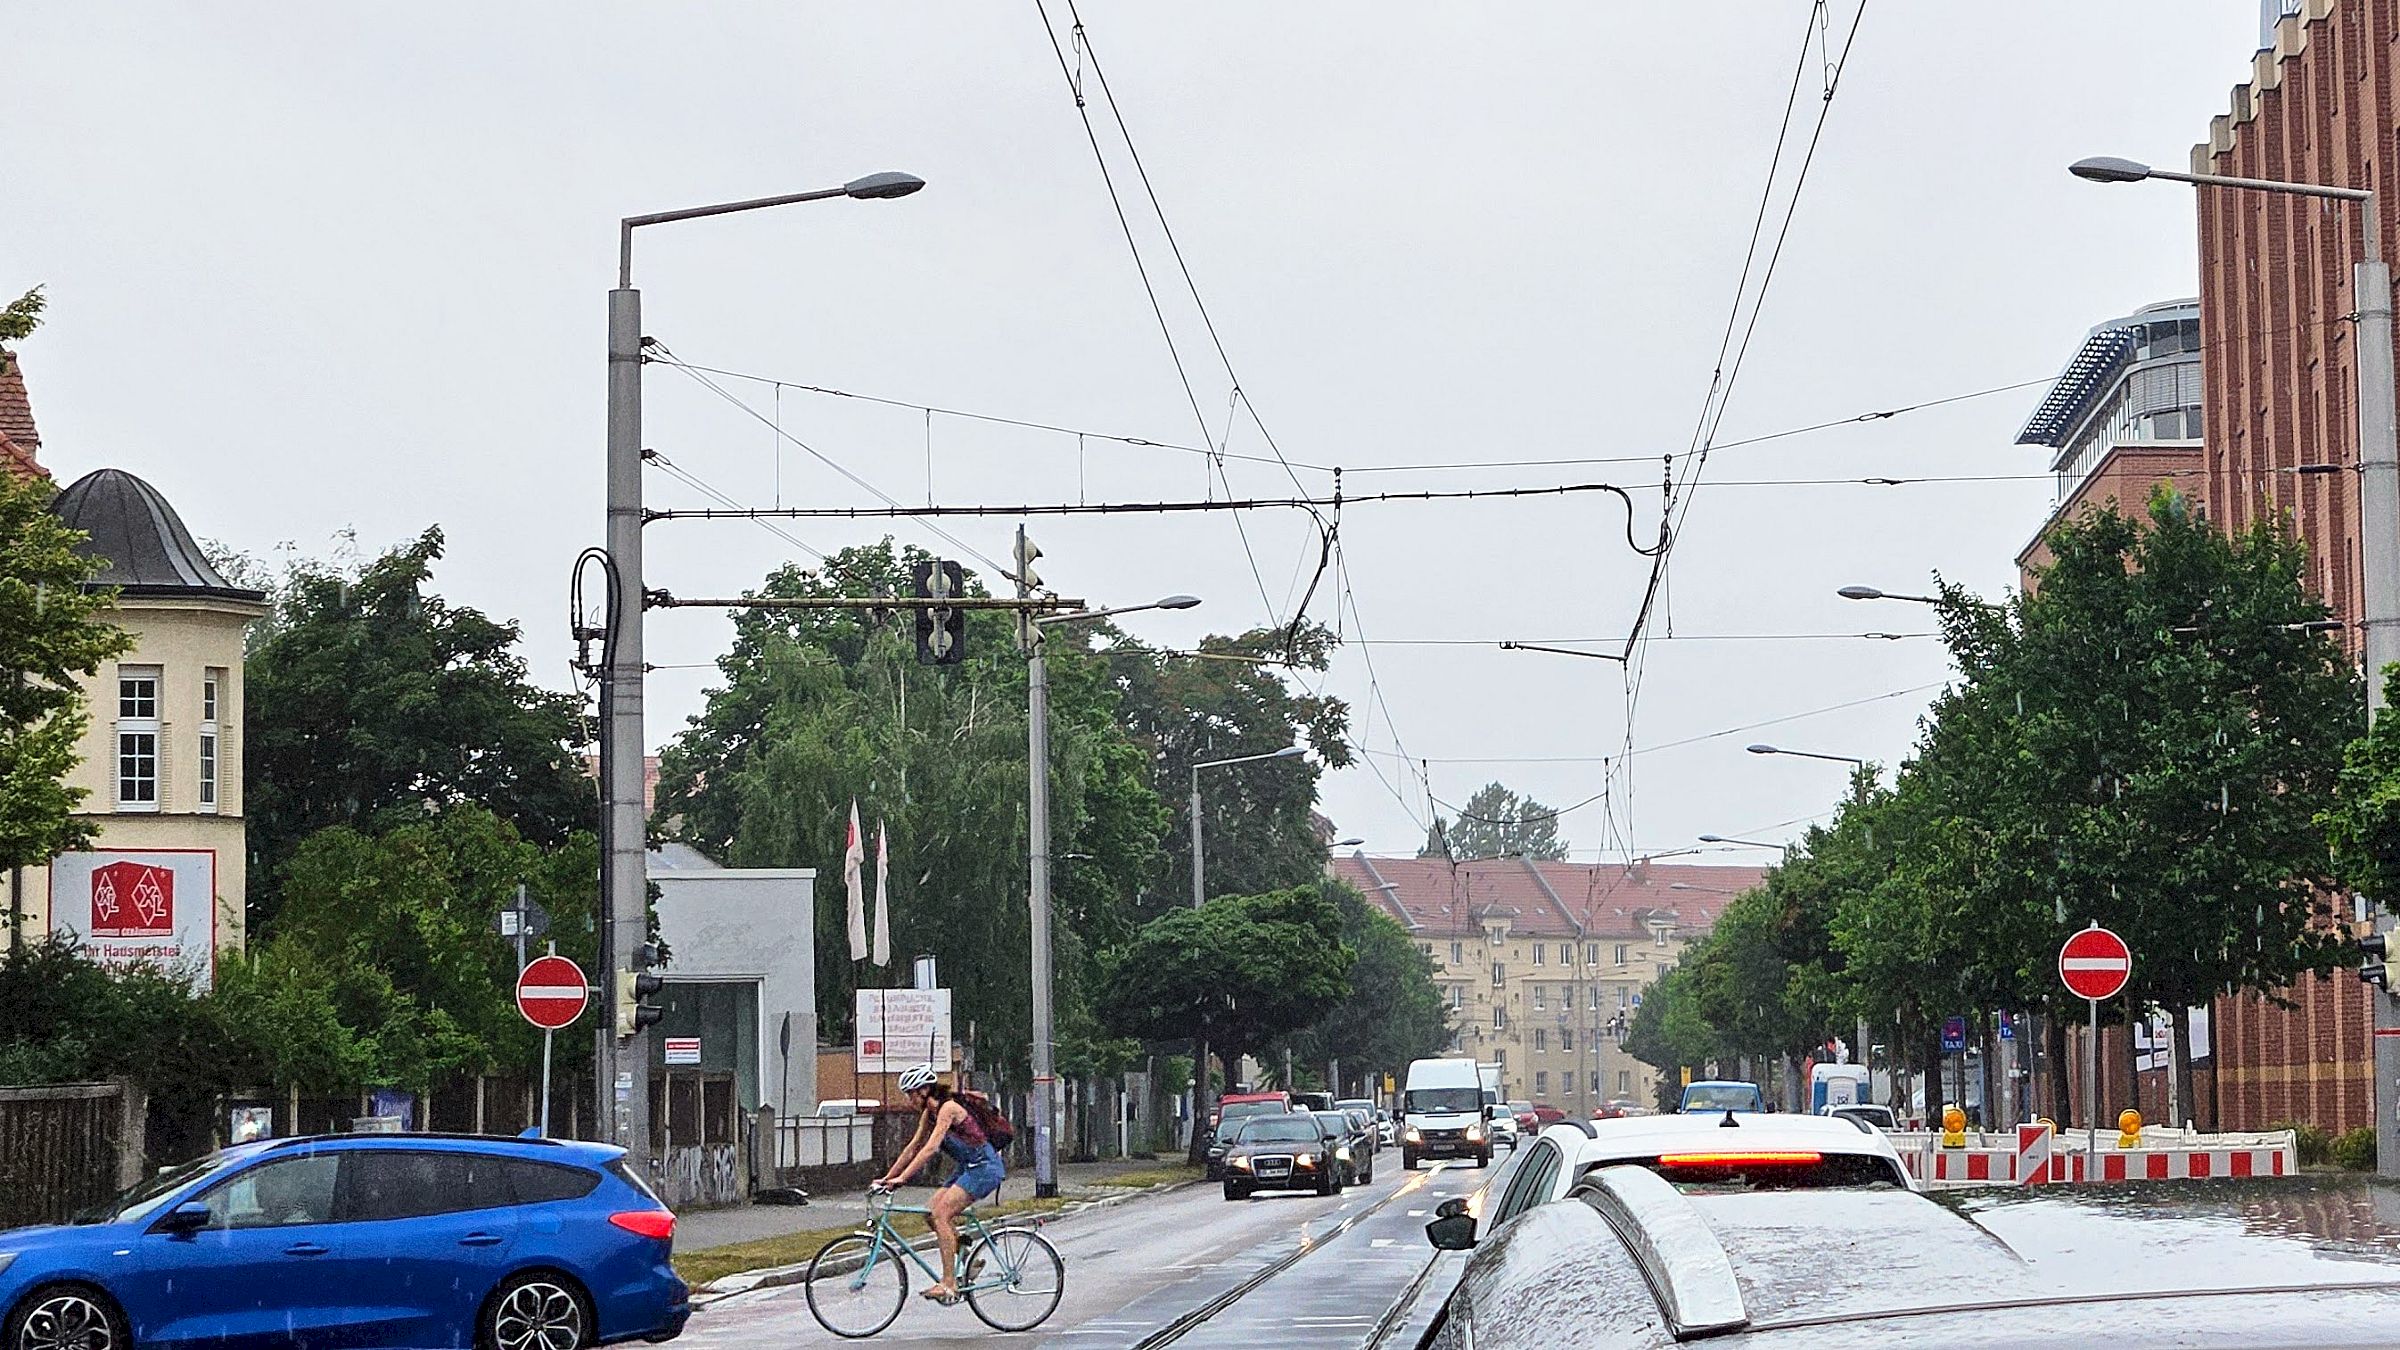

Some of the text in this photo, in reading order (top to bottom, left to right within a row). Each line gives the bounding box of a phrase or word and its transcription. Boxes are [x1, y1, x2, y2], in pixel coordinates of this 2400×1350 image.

[99, 886, 119, 913] XL
[138, 884, 167, 917] XL
[1944, 1040, 1963, 1049] TAXI
